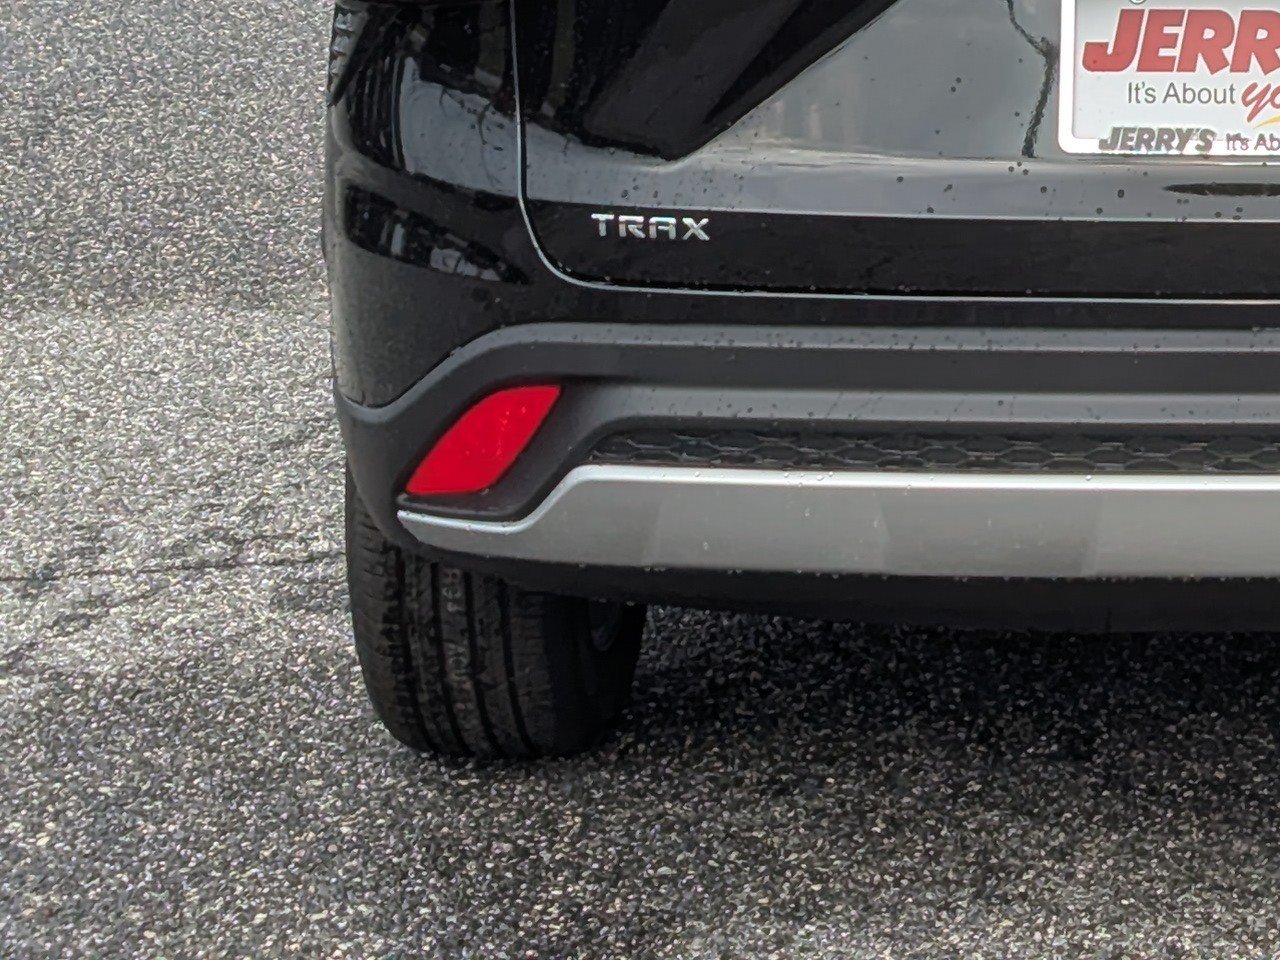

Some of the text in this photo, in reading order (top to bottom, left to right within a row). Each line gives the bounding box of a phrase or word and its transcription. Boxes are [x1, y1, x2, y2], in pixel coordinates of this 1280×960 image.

[1127, 81, 1156, 104] It's
[1162, 81, 1236, 105] About
[1098, 126, 1218, 152] JERRY'S
[1225, 133, 1250, 151] It's
[590, 213, 711, 241] TRAX
